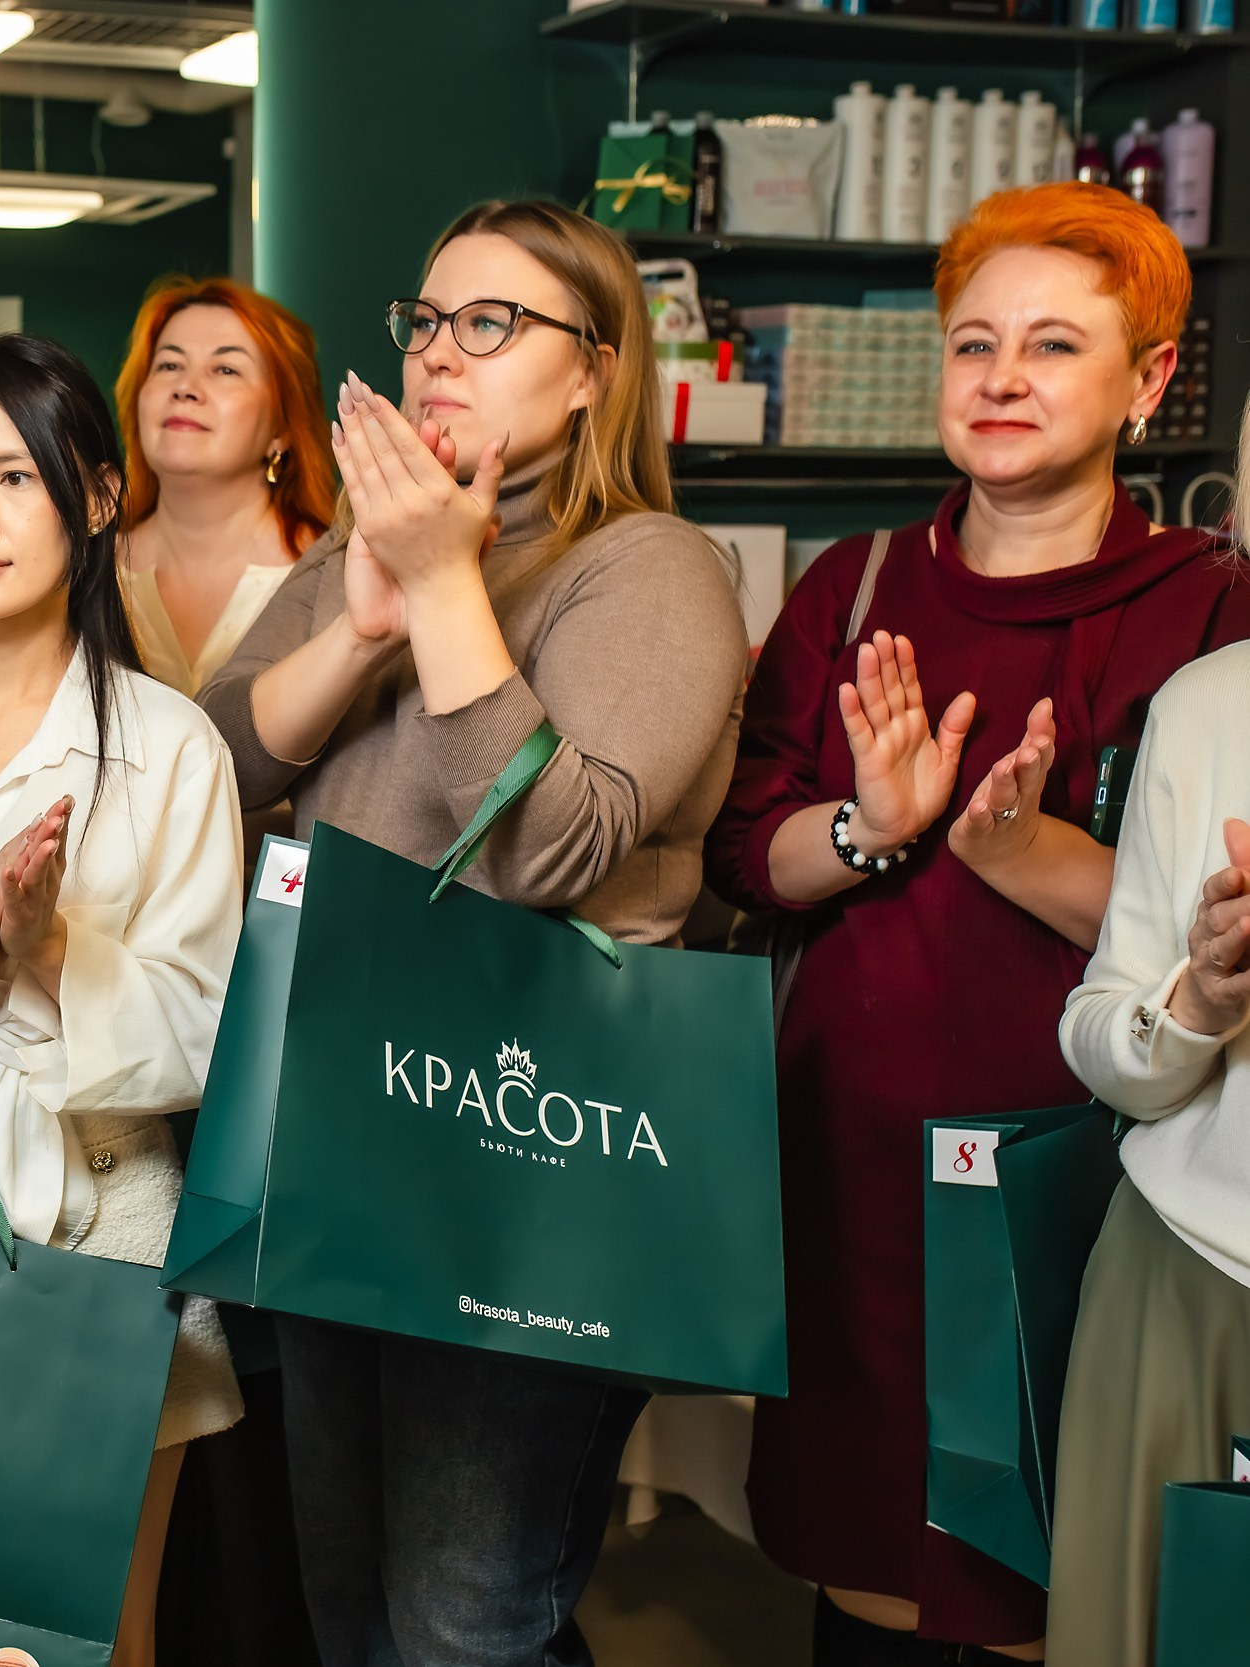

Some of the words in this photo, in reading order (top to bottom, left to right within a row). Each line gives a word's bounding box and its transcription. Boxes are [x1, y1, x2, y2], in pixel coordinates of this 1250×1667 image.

[281, 863, 305, 893] 4
[385, 1041, 668, 1167] КРАСОТА
[480, 1138, 523, 1157] БЬЮТИ
[532, 1152, 566, 1167] КАФЕ
[953, 1141, 977, 1173] 8
[472, 1299, 610, 1338] krasota_beauty_cafe
